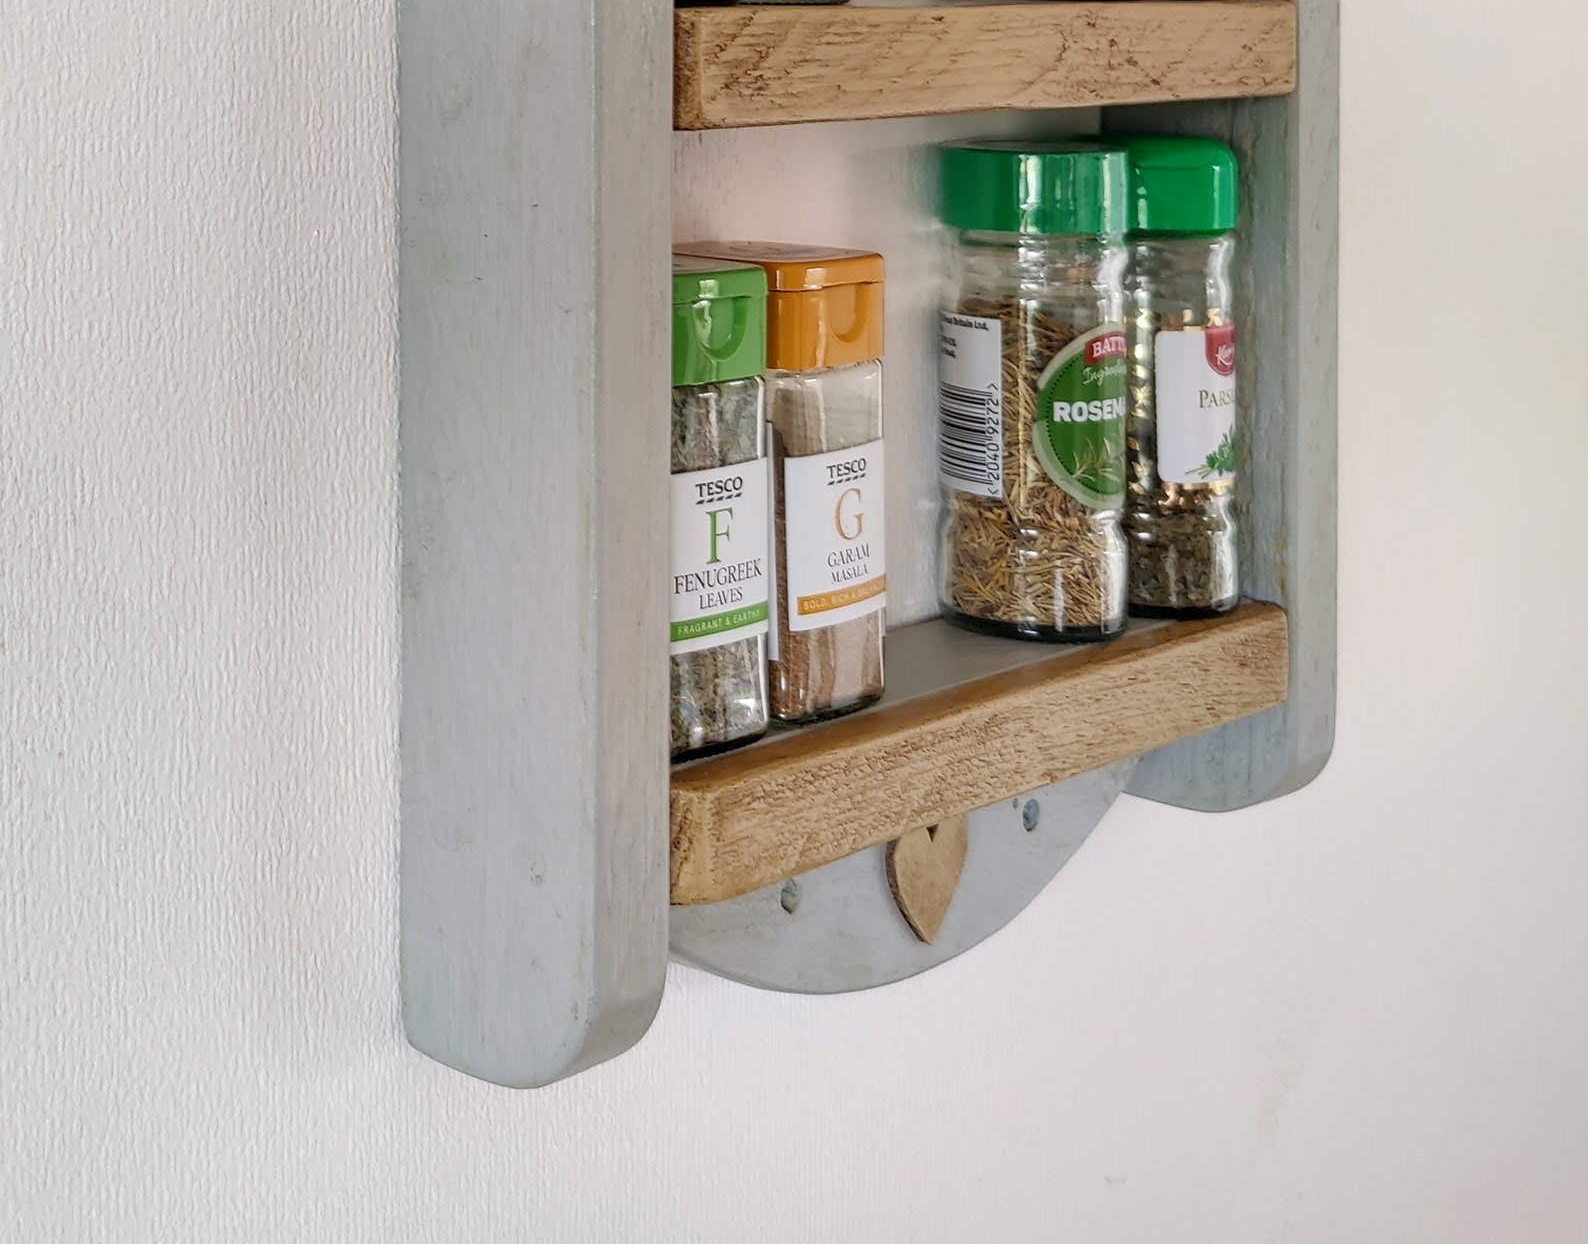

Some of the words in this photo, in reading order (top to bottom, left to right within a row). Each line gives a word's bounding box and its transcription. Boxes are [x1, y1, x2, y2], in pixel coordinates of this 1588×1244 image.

[827, 457, 867, 479] TESCO
[695, 476, 743, 498] TESCO
[834, 488, 864, 541] G
[705, 507, 733, 564] F
[827, 543, 870, 568] GARAM
[674, 557, 762, 595] FENUGREEK
[831, 563, 869, 584] MASALA
[699, 586, 743, 610] LEAVES
[677, 618, 722, 636] FRAGRANT
[725, 617, 731, 626] &
[733, 609, 761, 624] EARTHY
